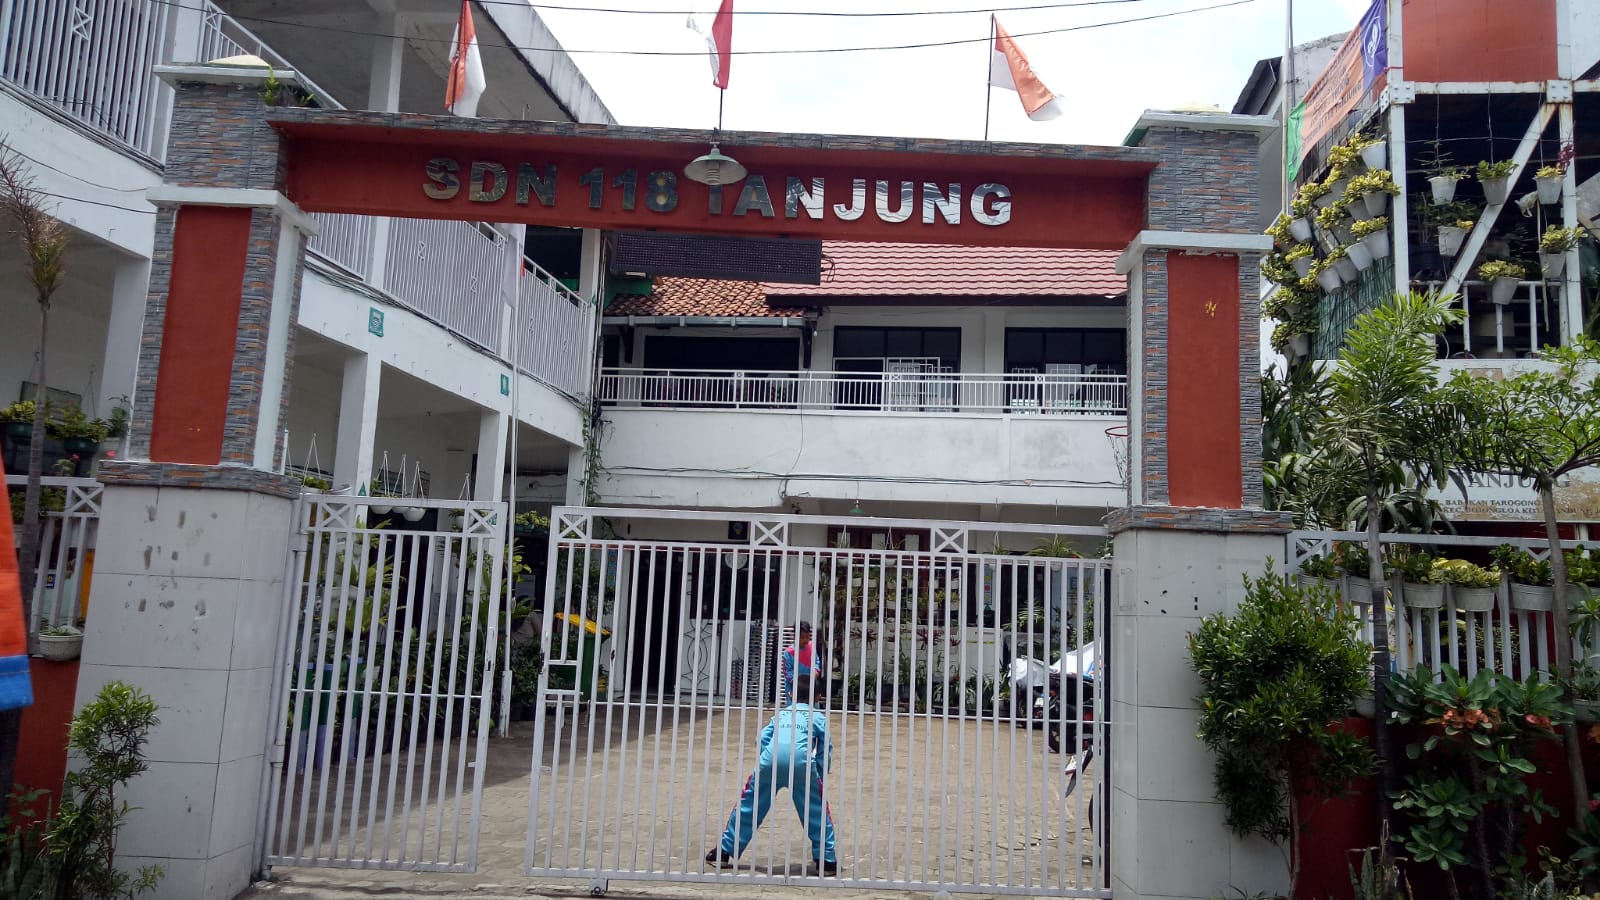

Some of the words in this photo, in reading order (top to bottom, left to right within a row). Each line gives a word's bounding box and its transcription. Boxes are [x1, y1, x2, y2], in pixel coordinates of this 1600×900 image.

[422, 157, 558, 207] SDN
[580, 167, 679, 213] 118
[1456, 470, 1570, 490] ANJUG
